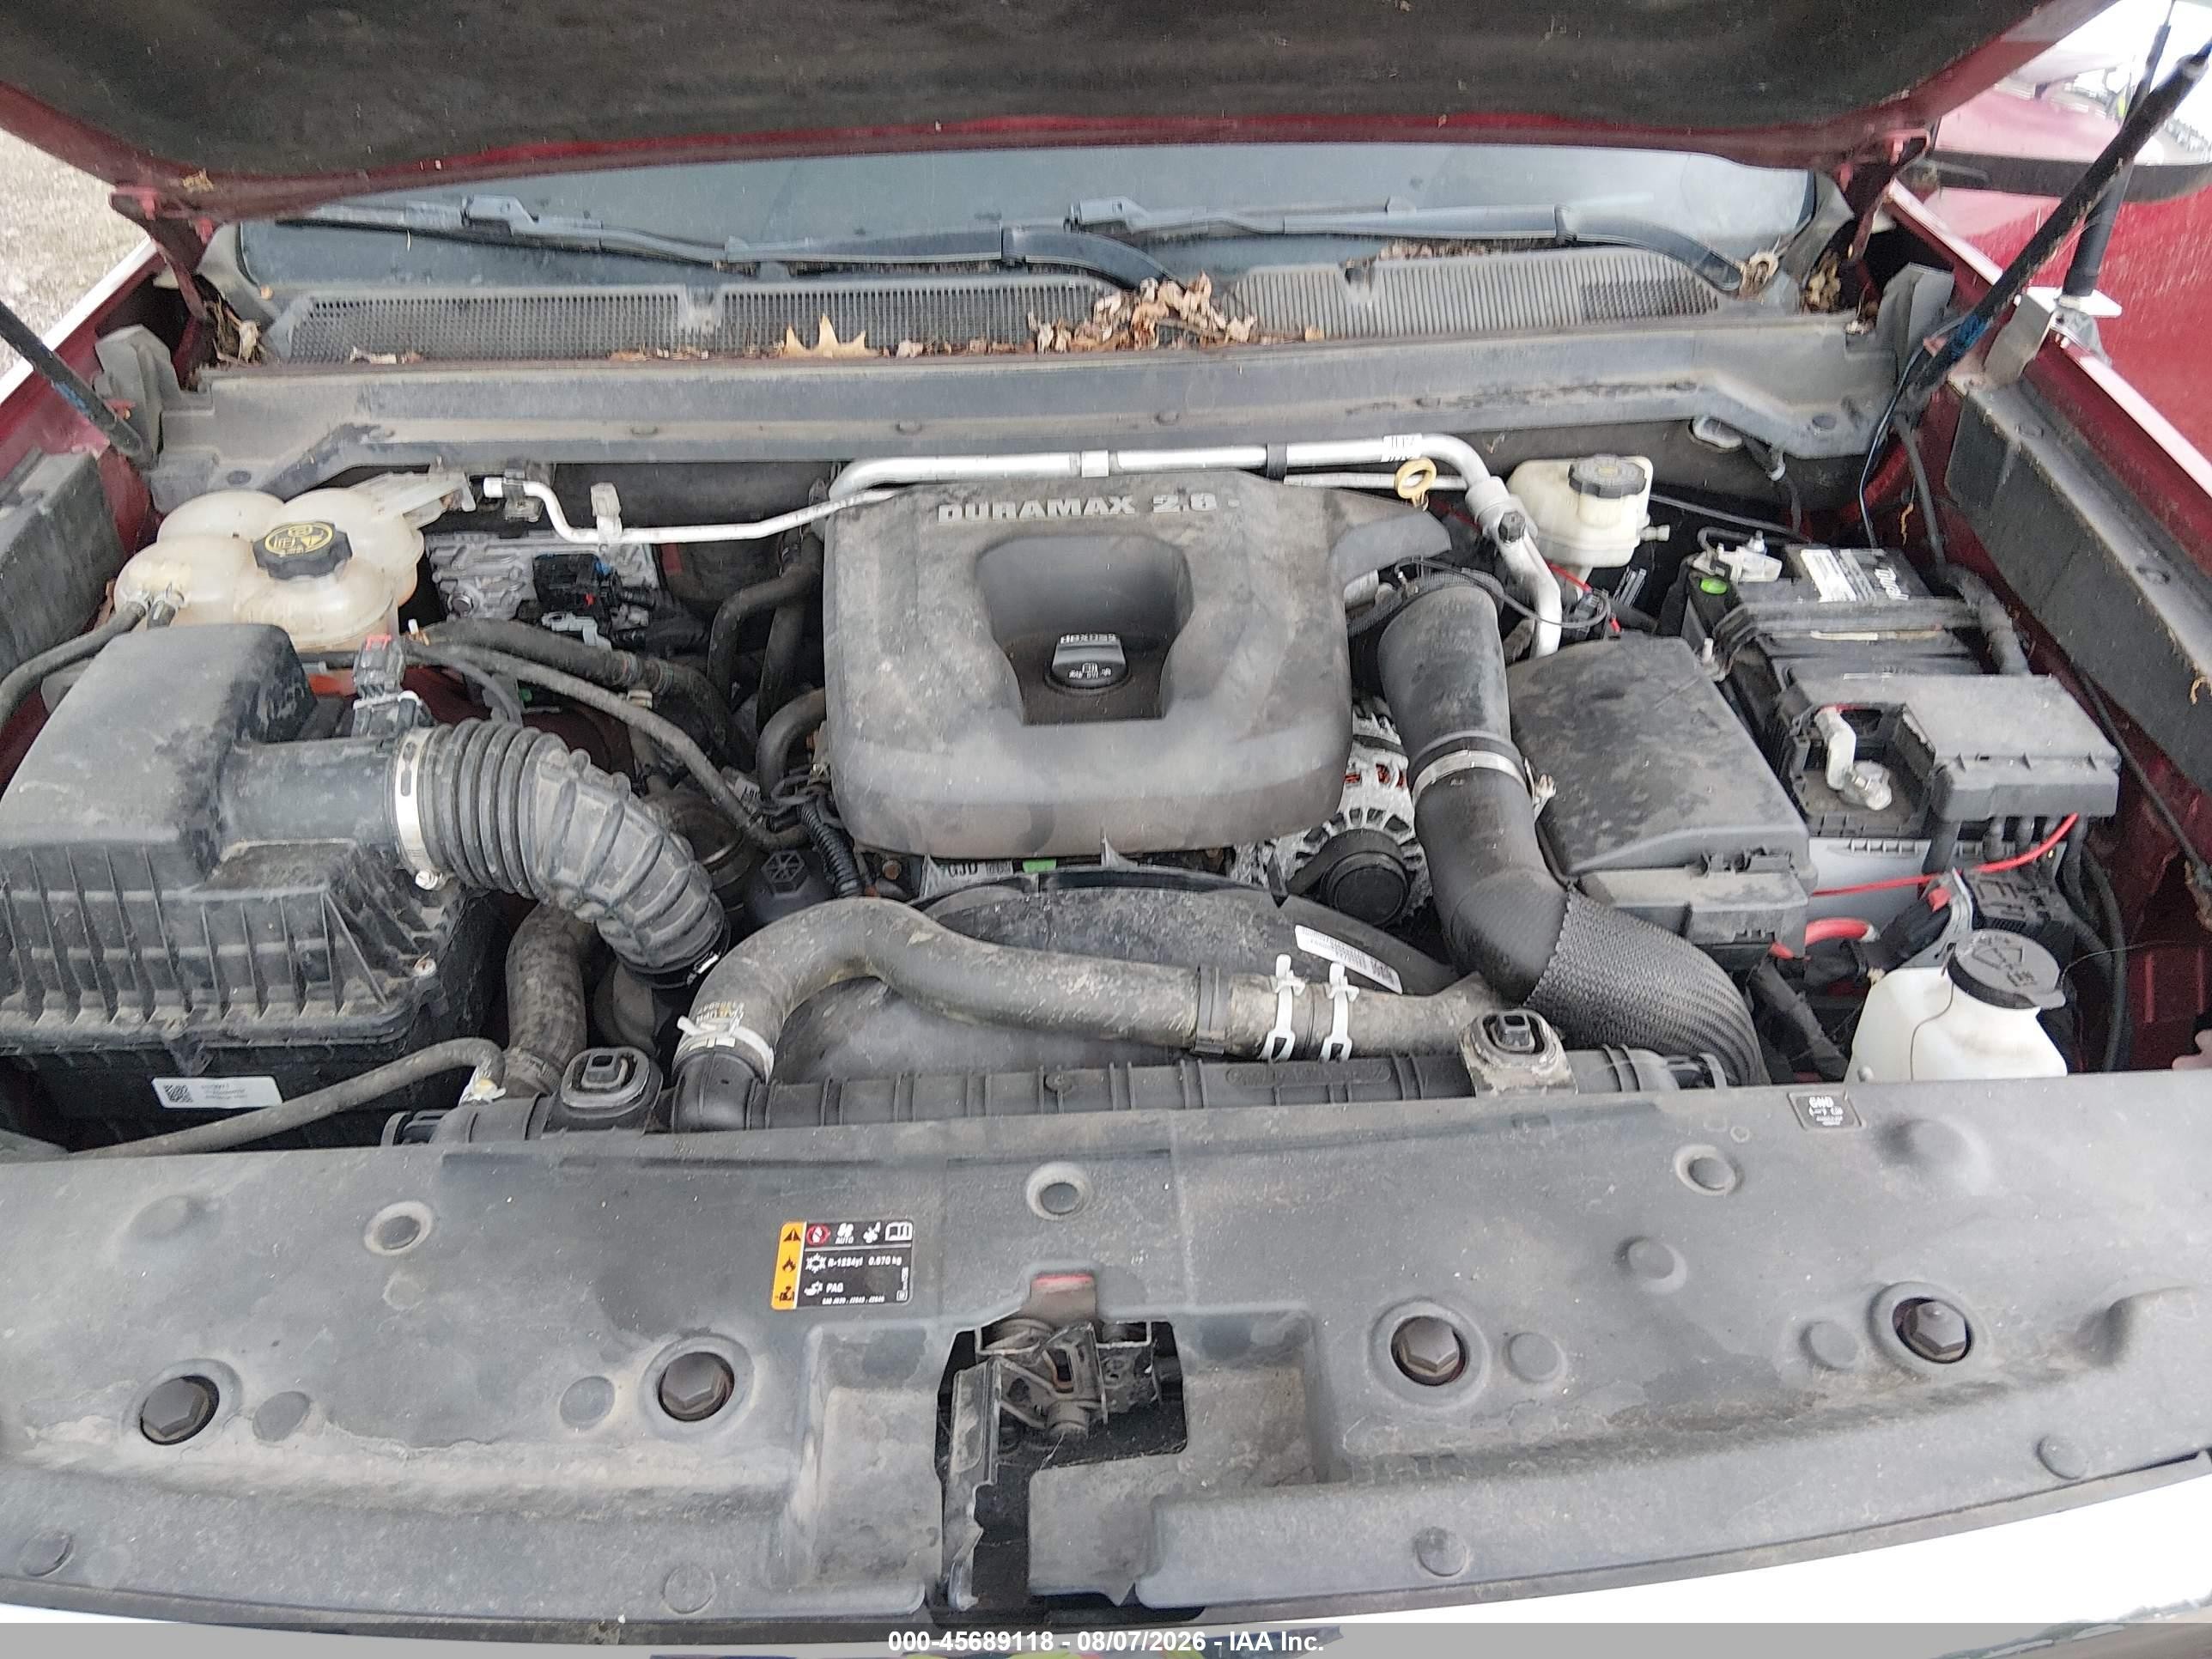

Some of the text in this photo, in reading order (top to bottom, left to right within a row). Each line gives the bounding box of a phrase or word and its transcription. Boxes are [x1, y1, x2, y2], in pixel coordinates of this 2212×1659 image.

[938, 495, 1136, 523] DURAMAX
[835, 1236, 854, 1244] AUTO
[891, 1255, 902, 1267] kg
